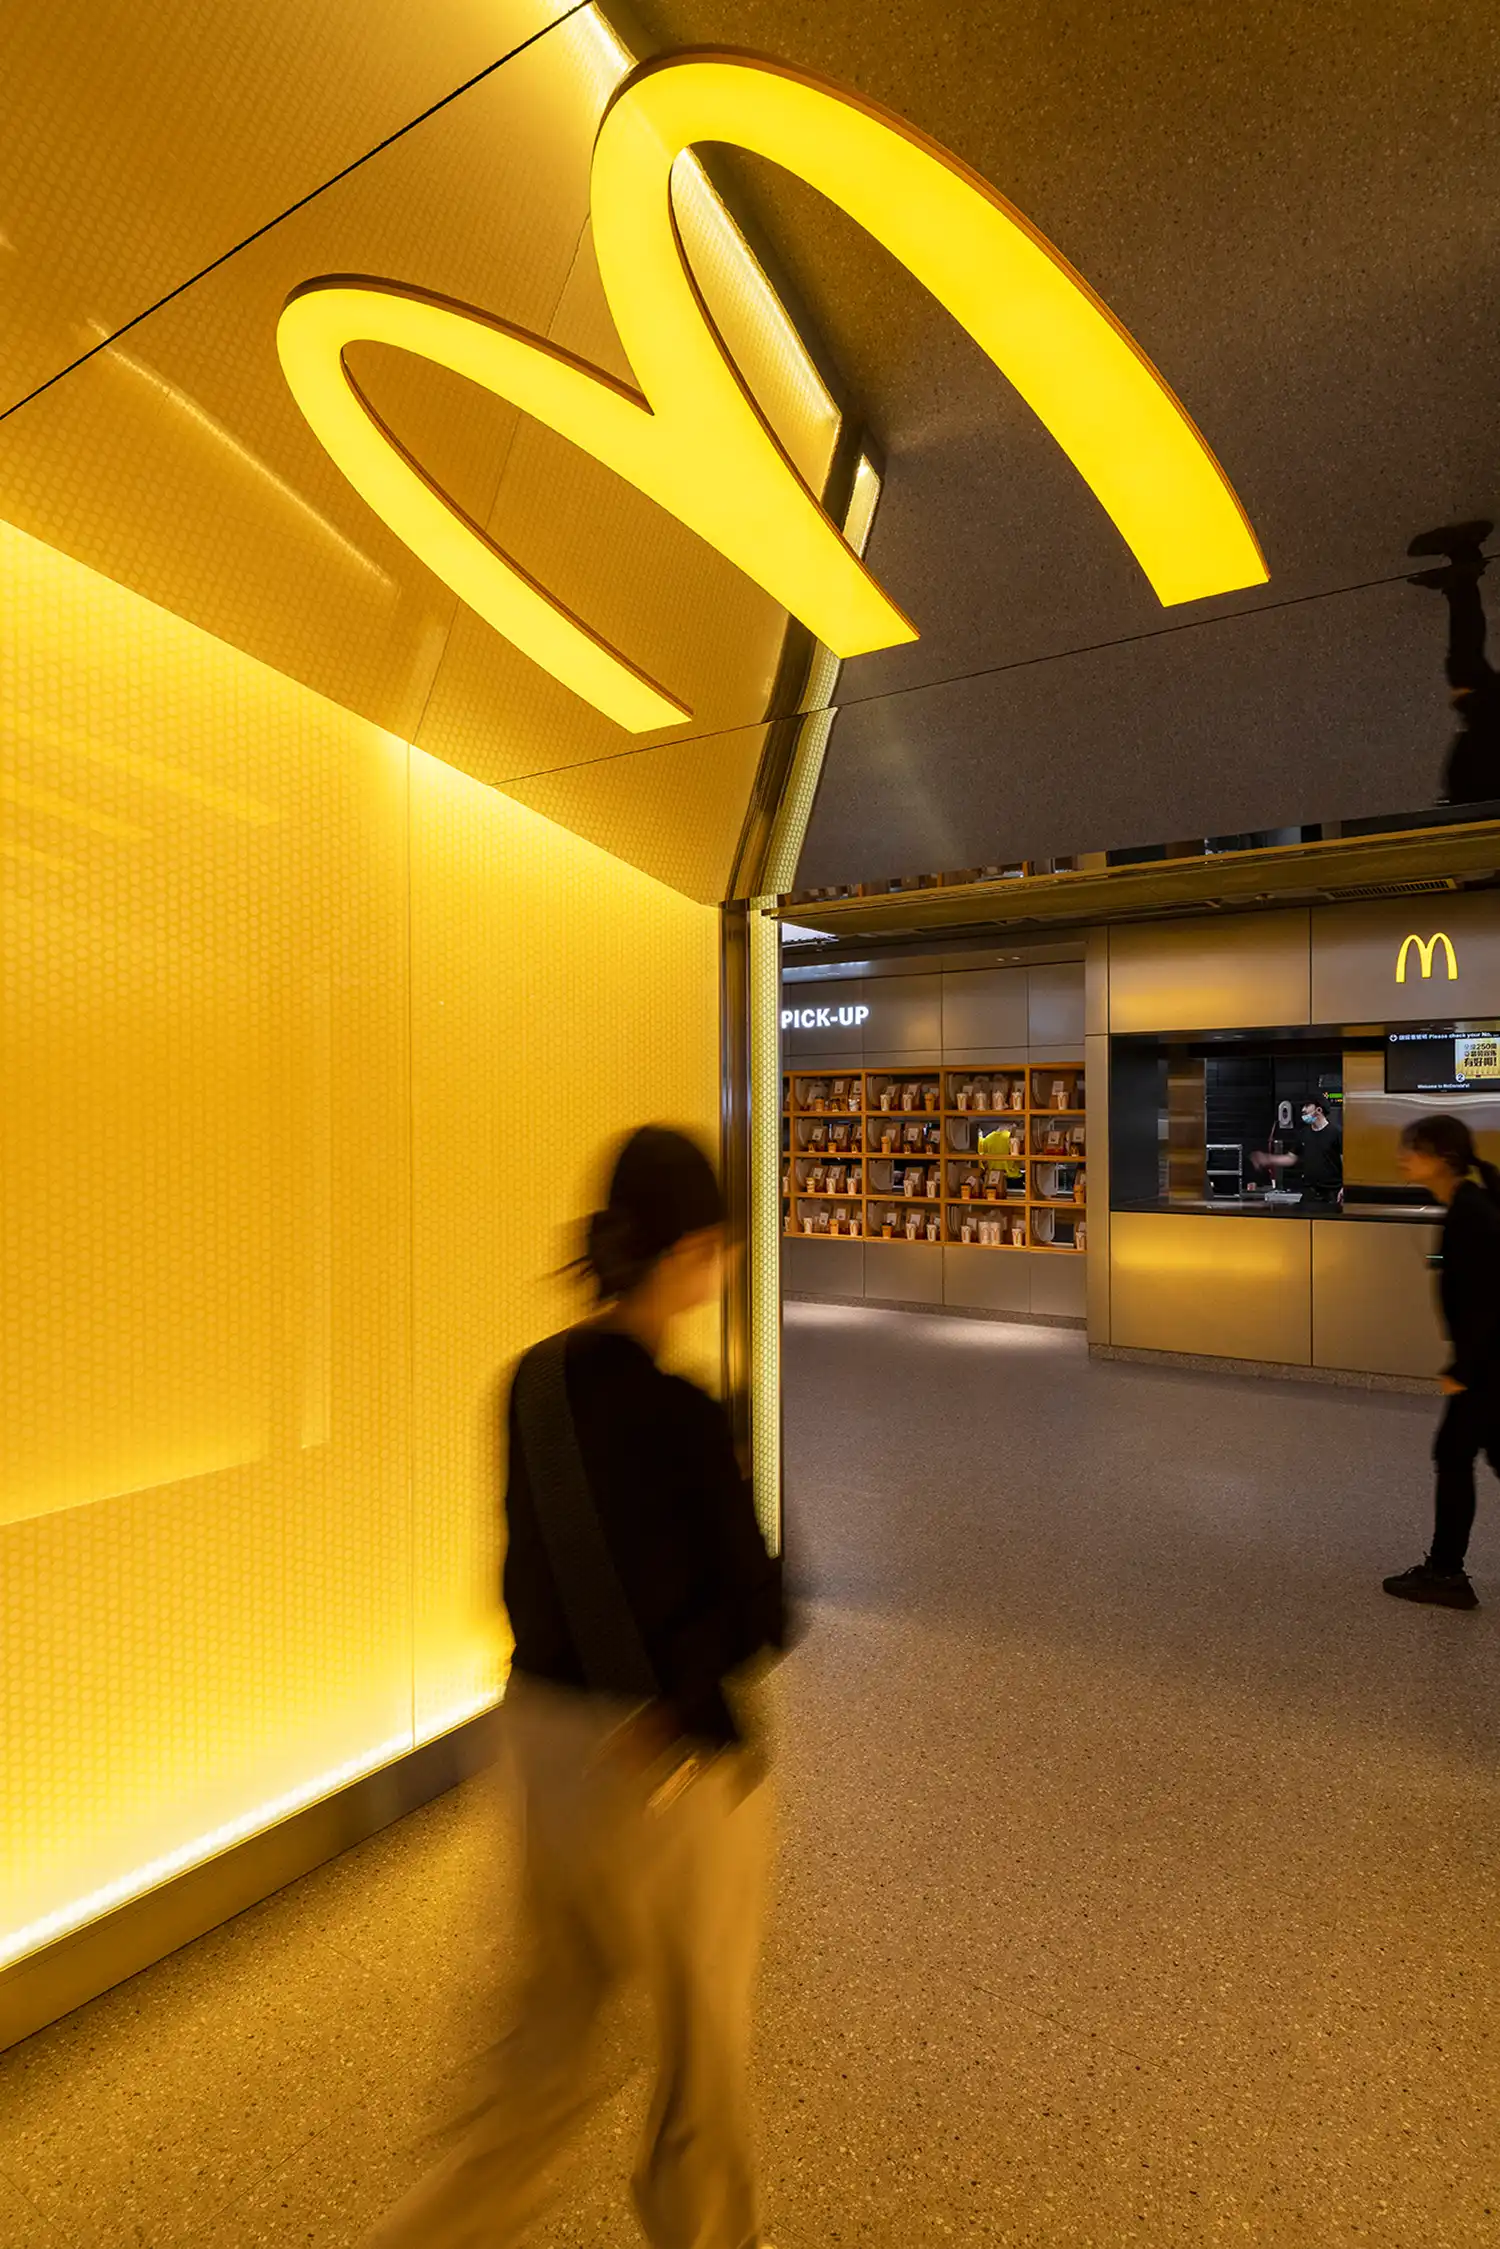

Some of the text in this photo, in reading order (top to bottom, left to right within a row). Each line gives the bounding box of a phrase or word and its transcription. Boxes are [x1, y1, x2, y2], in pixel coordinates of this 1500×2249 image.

[276, 43, 1269, 734] M
[1395, 932, 1459, 983] M
[780, 1005, 869, 1029] PICK-UP
